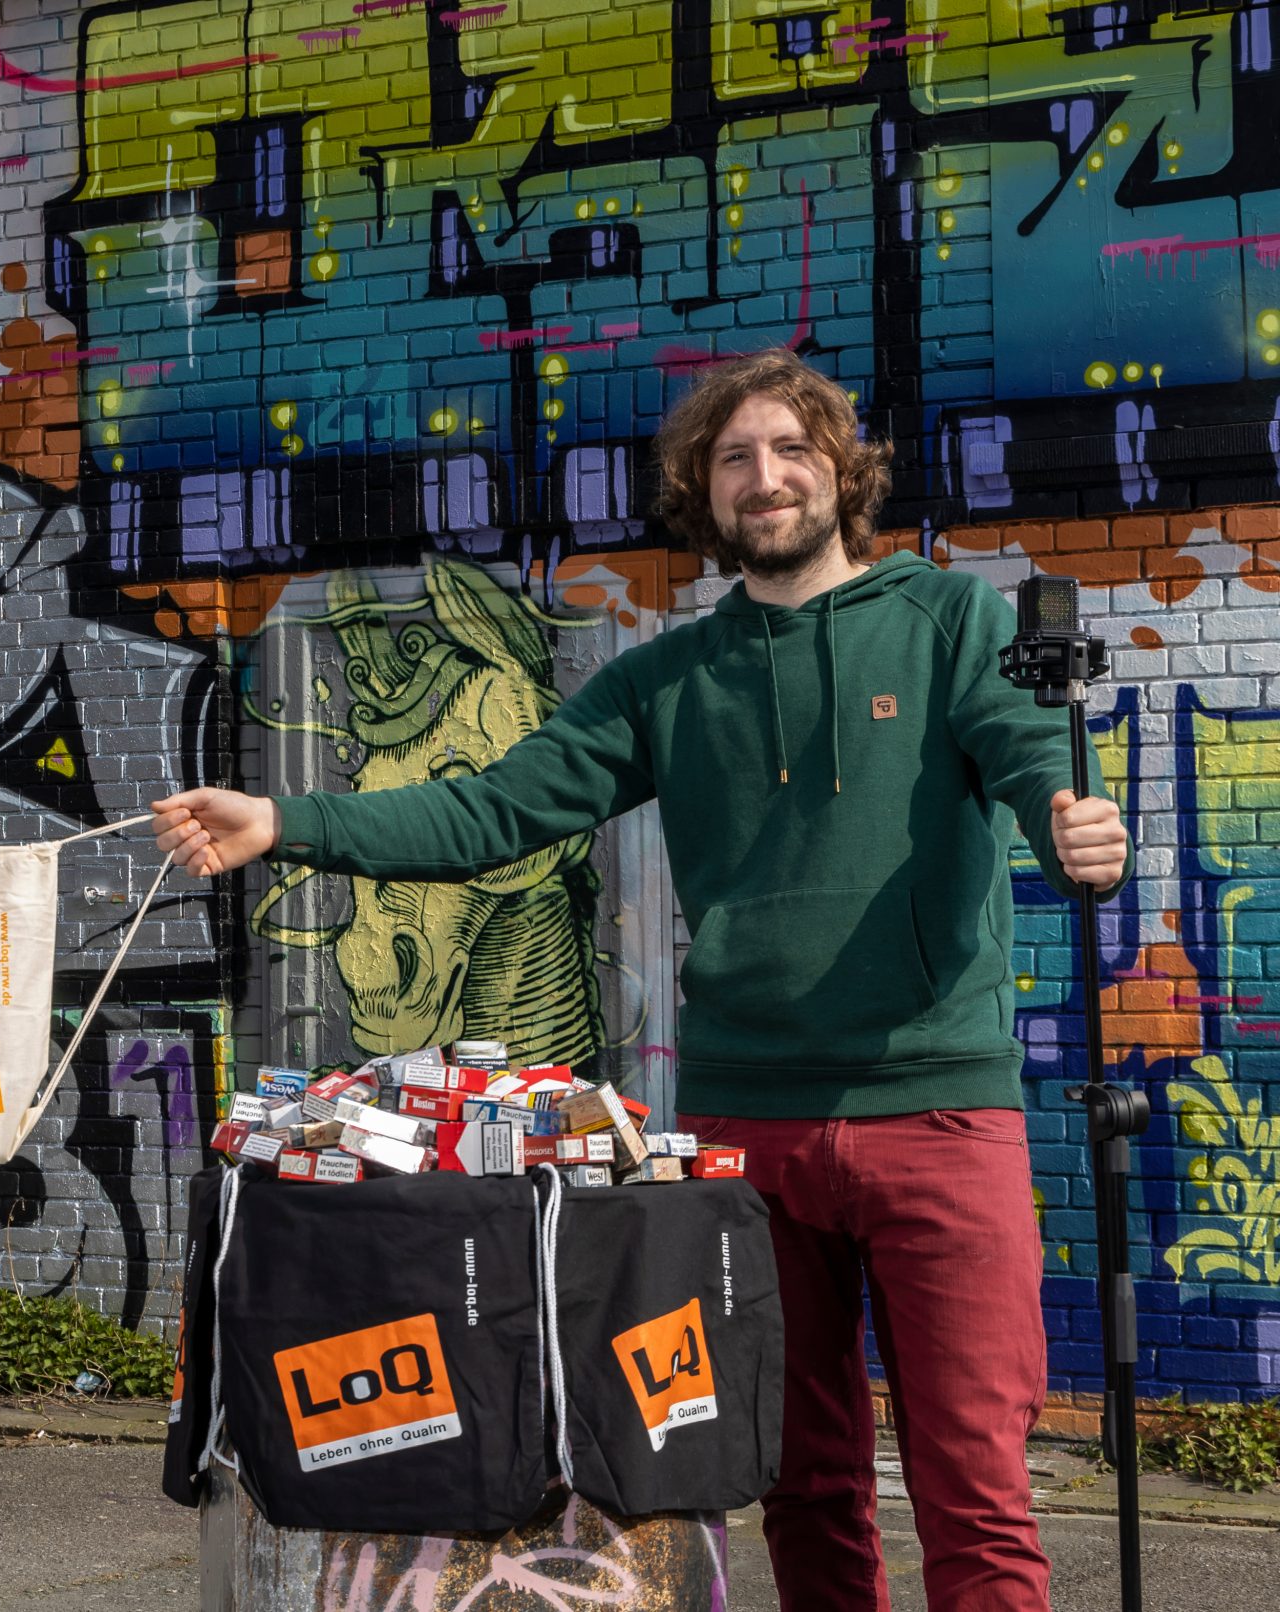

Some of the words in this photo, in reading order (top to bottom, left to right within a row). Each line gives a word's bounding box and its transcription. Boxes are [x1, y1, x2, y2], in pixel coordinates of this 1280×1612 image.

[264, 1082, 296, 1096] West
[500, 1109, 532, 1121] Rauchen
[320, 1158, 354, 1169] Rauchen
[327, 1170, 354, 1179] tödlich
[587, 1171, 604, 1181] West
[721, 1232, 732, 1316] www-loq.de
[464, 1238, 478, 1327] www-loq.de
[290, 1342, 436, 1420] LoQ
[678, 1404, 708, 1419] Qualm
[310, 1443, 353, 1464] Leben
[358, 1433, 394, 1452] ohne
[400, 1421, 448, 1443] Qualm
